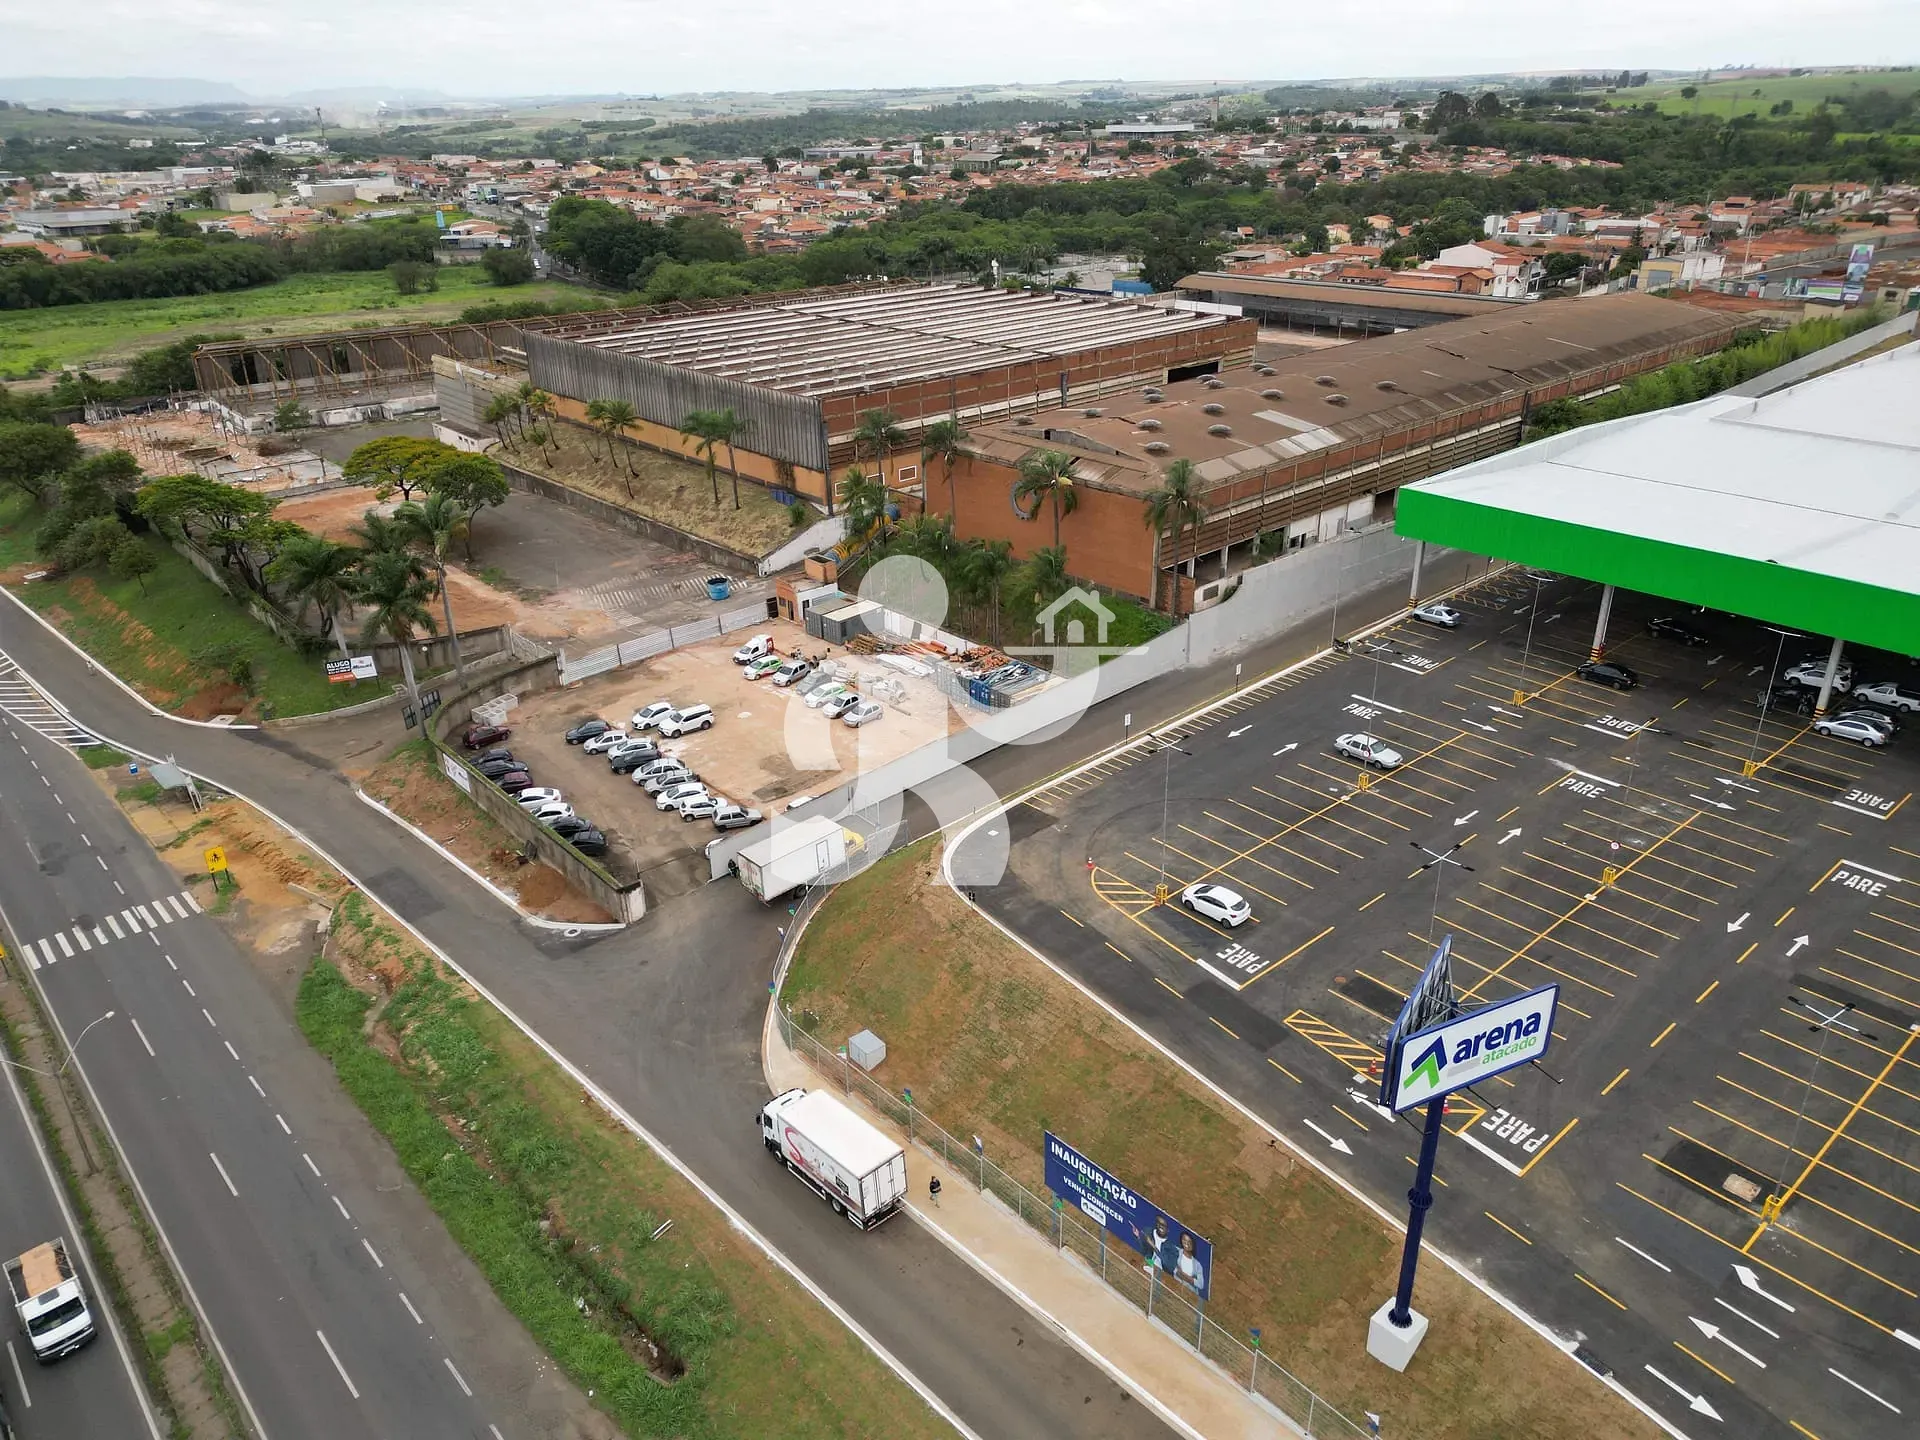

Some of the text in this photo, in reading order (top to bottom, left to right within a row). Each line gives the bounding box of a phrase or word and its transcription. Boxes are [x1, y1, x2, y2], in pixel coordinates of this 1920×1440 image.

[326, 660, 350, 669] ALUGO
[1402, 654, 1440, 669] PARE
[1341, 703, 1383, 720] PARE
[1597, 714, 1641, 732] PARE
[1559, 778, 1605, 798] PARE
[1844, 789, 1895, 811] PARE
[1830, 870, 1887, 897] PARE
[1216, 943, 1270, 974] PARE
[1452, 1012, 1542, 1064] arena
[1482, 1036, 1537, 1065] atacado
[1480, 1108, 1550, 1153] PARE
[1051, 1141, 1137, 1209] INAUGURAÇÃO
[1078, 1173, 1109, 1202] 01.11
[1063, 1175, 1086, 1197] VENHA
[1087, 1192, 1124, 1223] CONHECER
